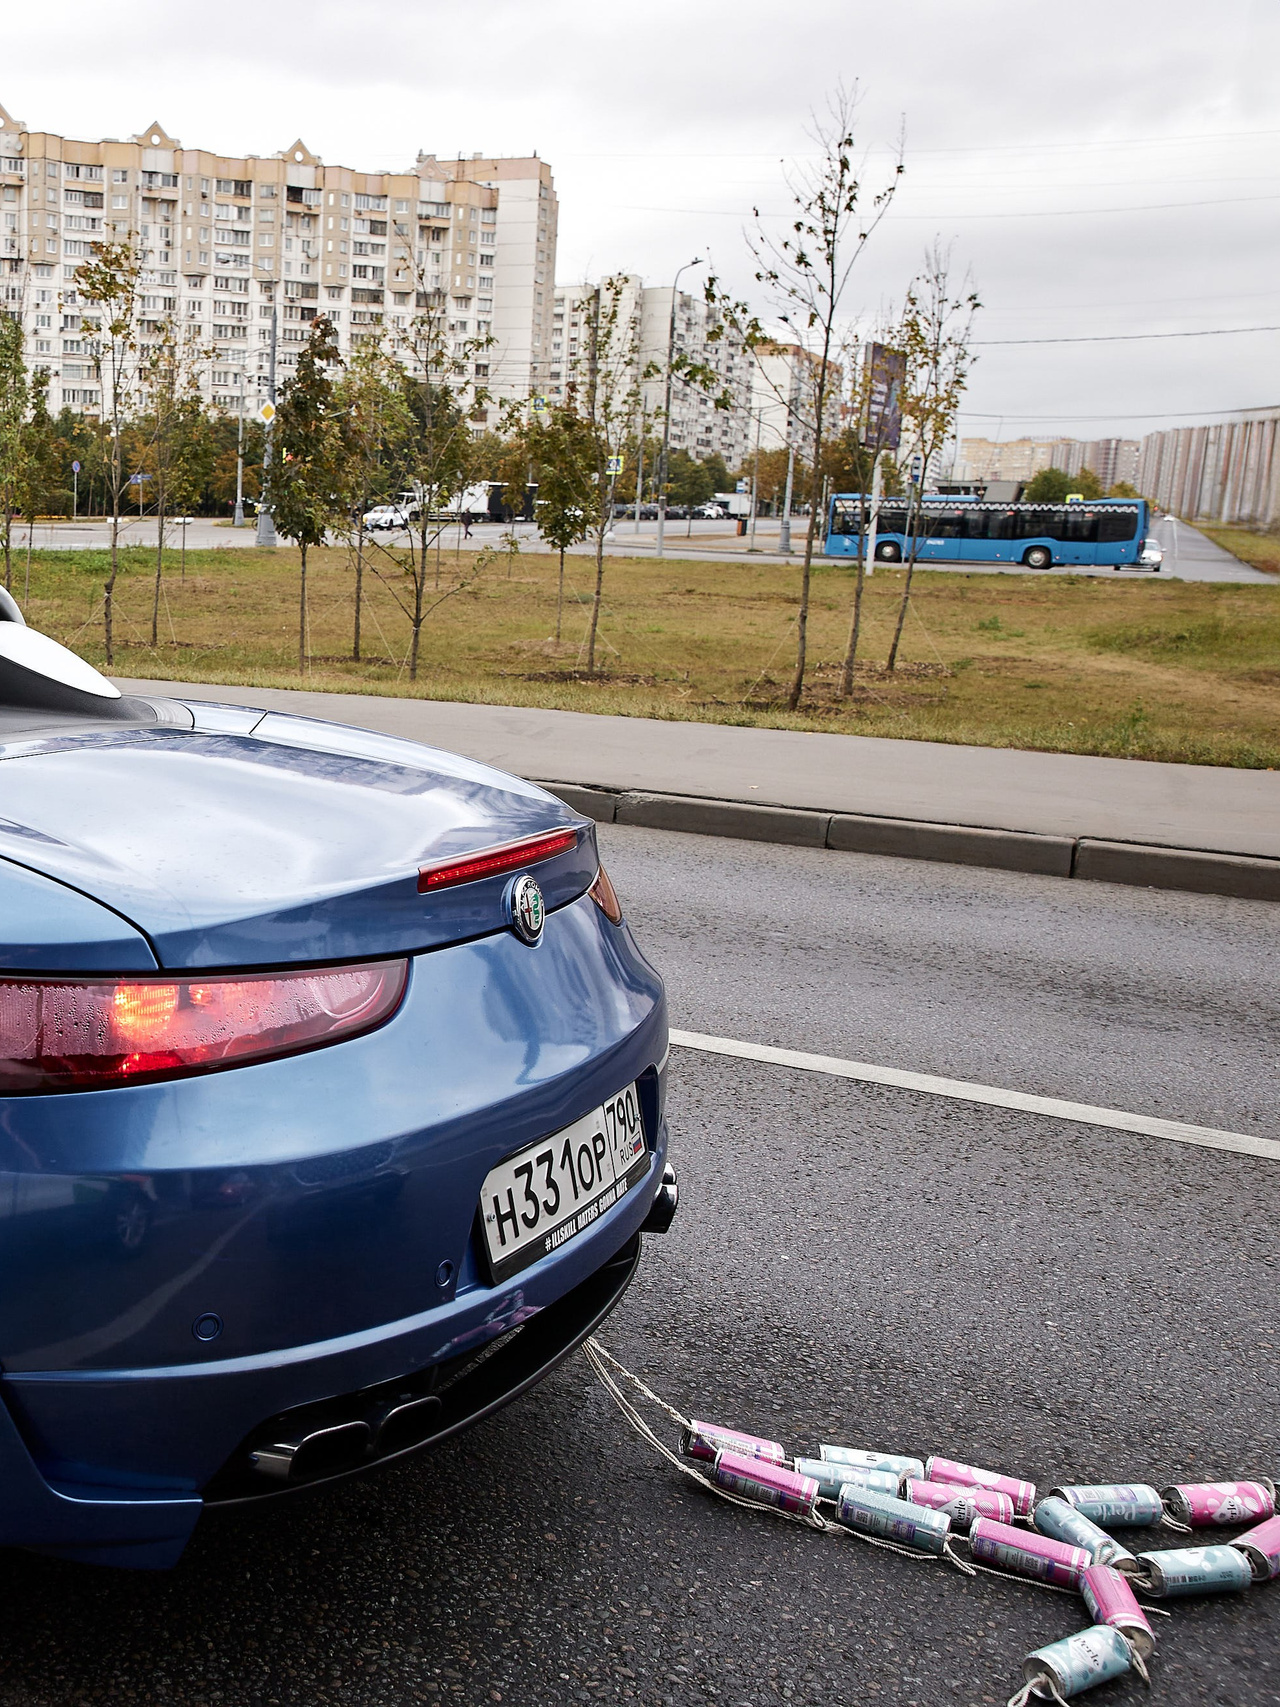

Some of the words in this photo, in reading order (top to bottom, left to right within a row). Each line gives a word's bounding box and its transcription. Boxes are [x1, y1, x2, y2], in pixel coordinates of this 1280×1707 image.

[606, 1089, 636, 1151] 790
[620, 1146, 634, 1166] RUS
[577, 1202, 599, 1230] HATERS
[599, 1187, 617, 1213] GONNA
[616, 1177, 628, 1199] HATE
[952, 1500, 966, 1525] Perle
[1093, 1503, 1136, 1521] Perle
[1073, 1638, 1100, 1667] Perle
